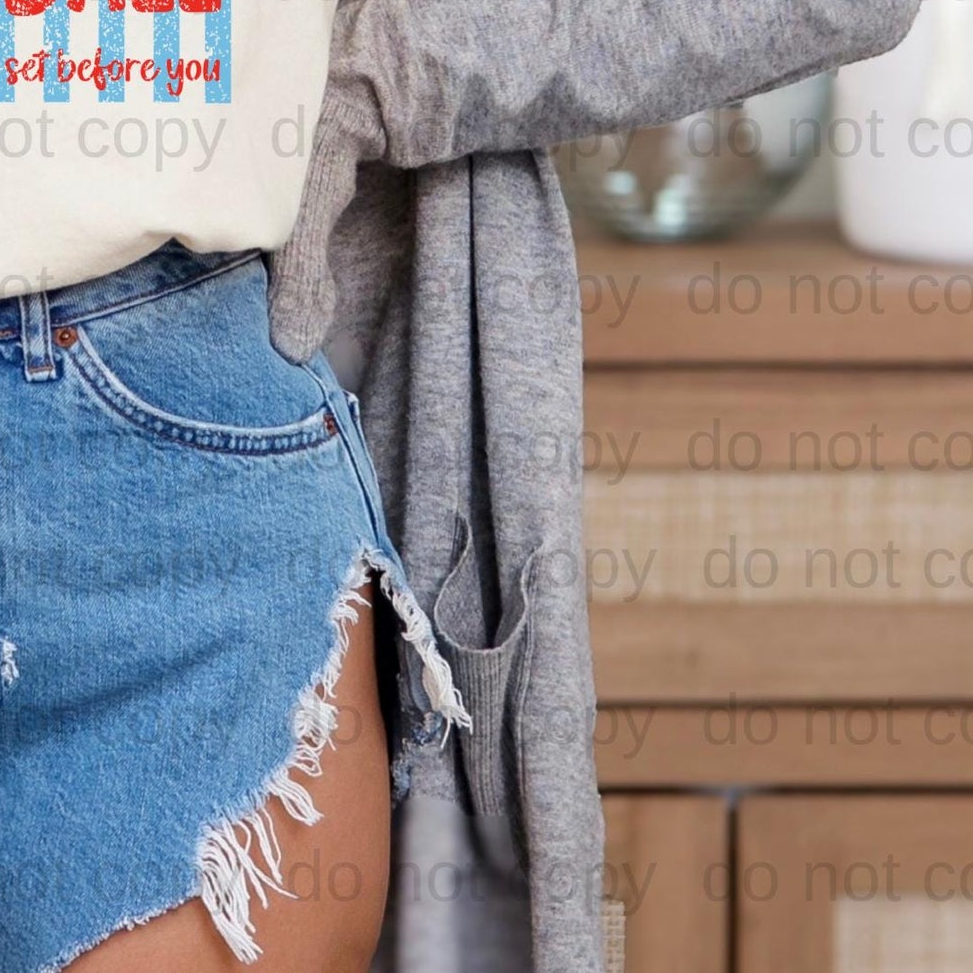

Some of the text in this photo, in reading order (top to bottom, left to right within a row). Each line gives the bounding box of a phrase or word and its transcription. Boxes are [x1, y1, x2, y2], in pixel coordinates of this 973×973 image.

[4, 49, 51, 85] set
[57, 47, 161, 91] before
[165, 58, 221, 97] you
